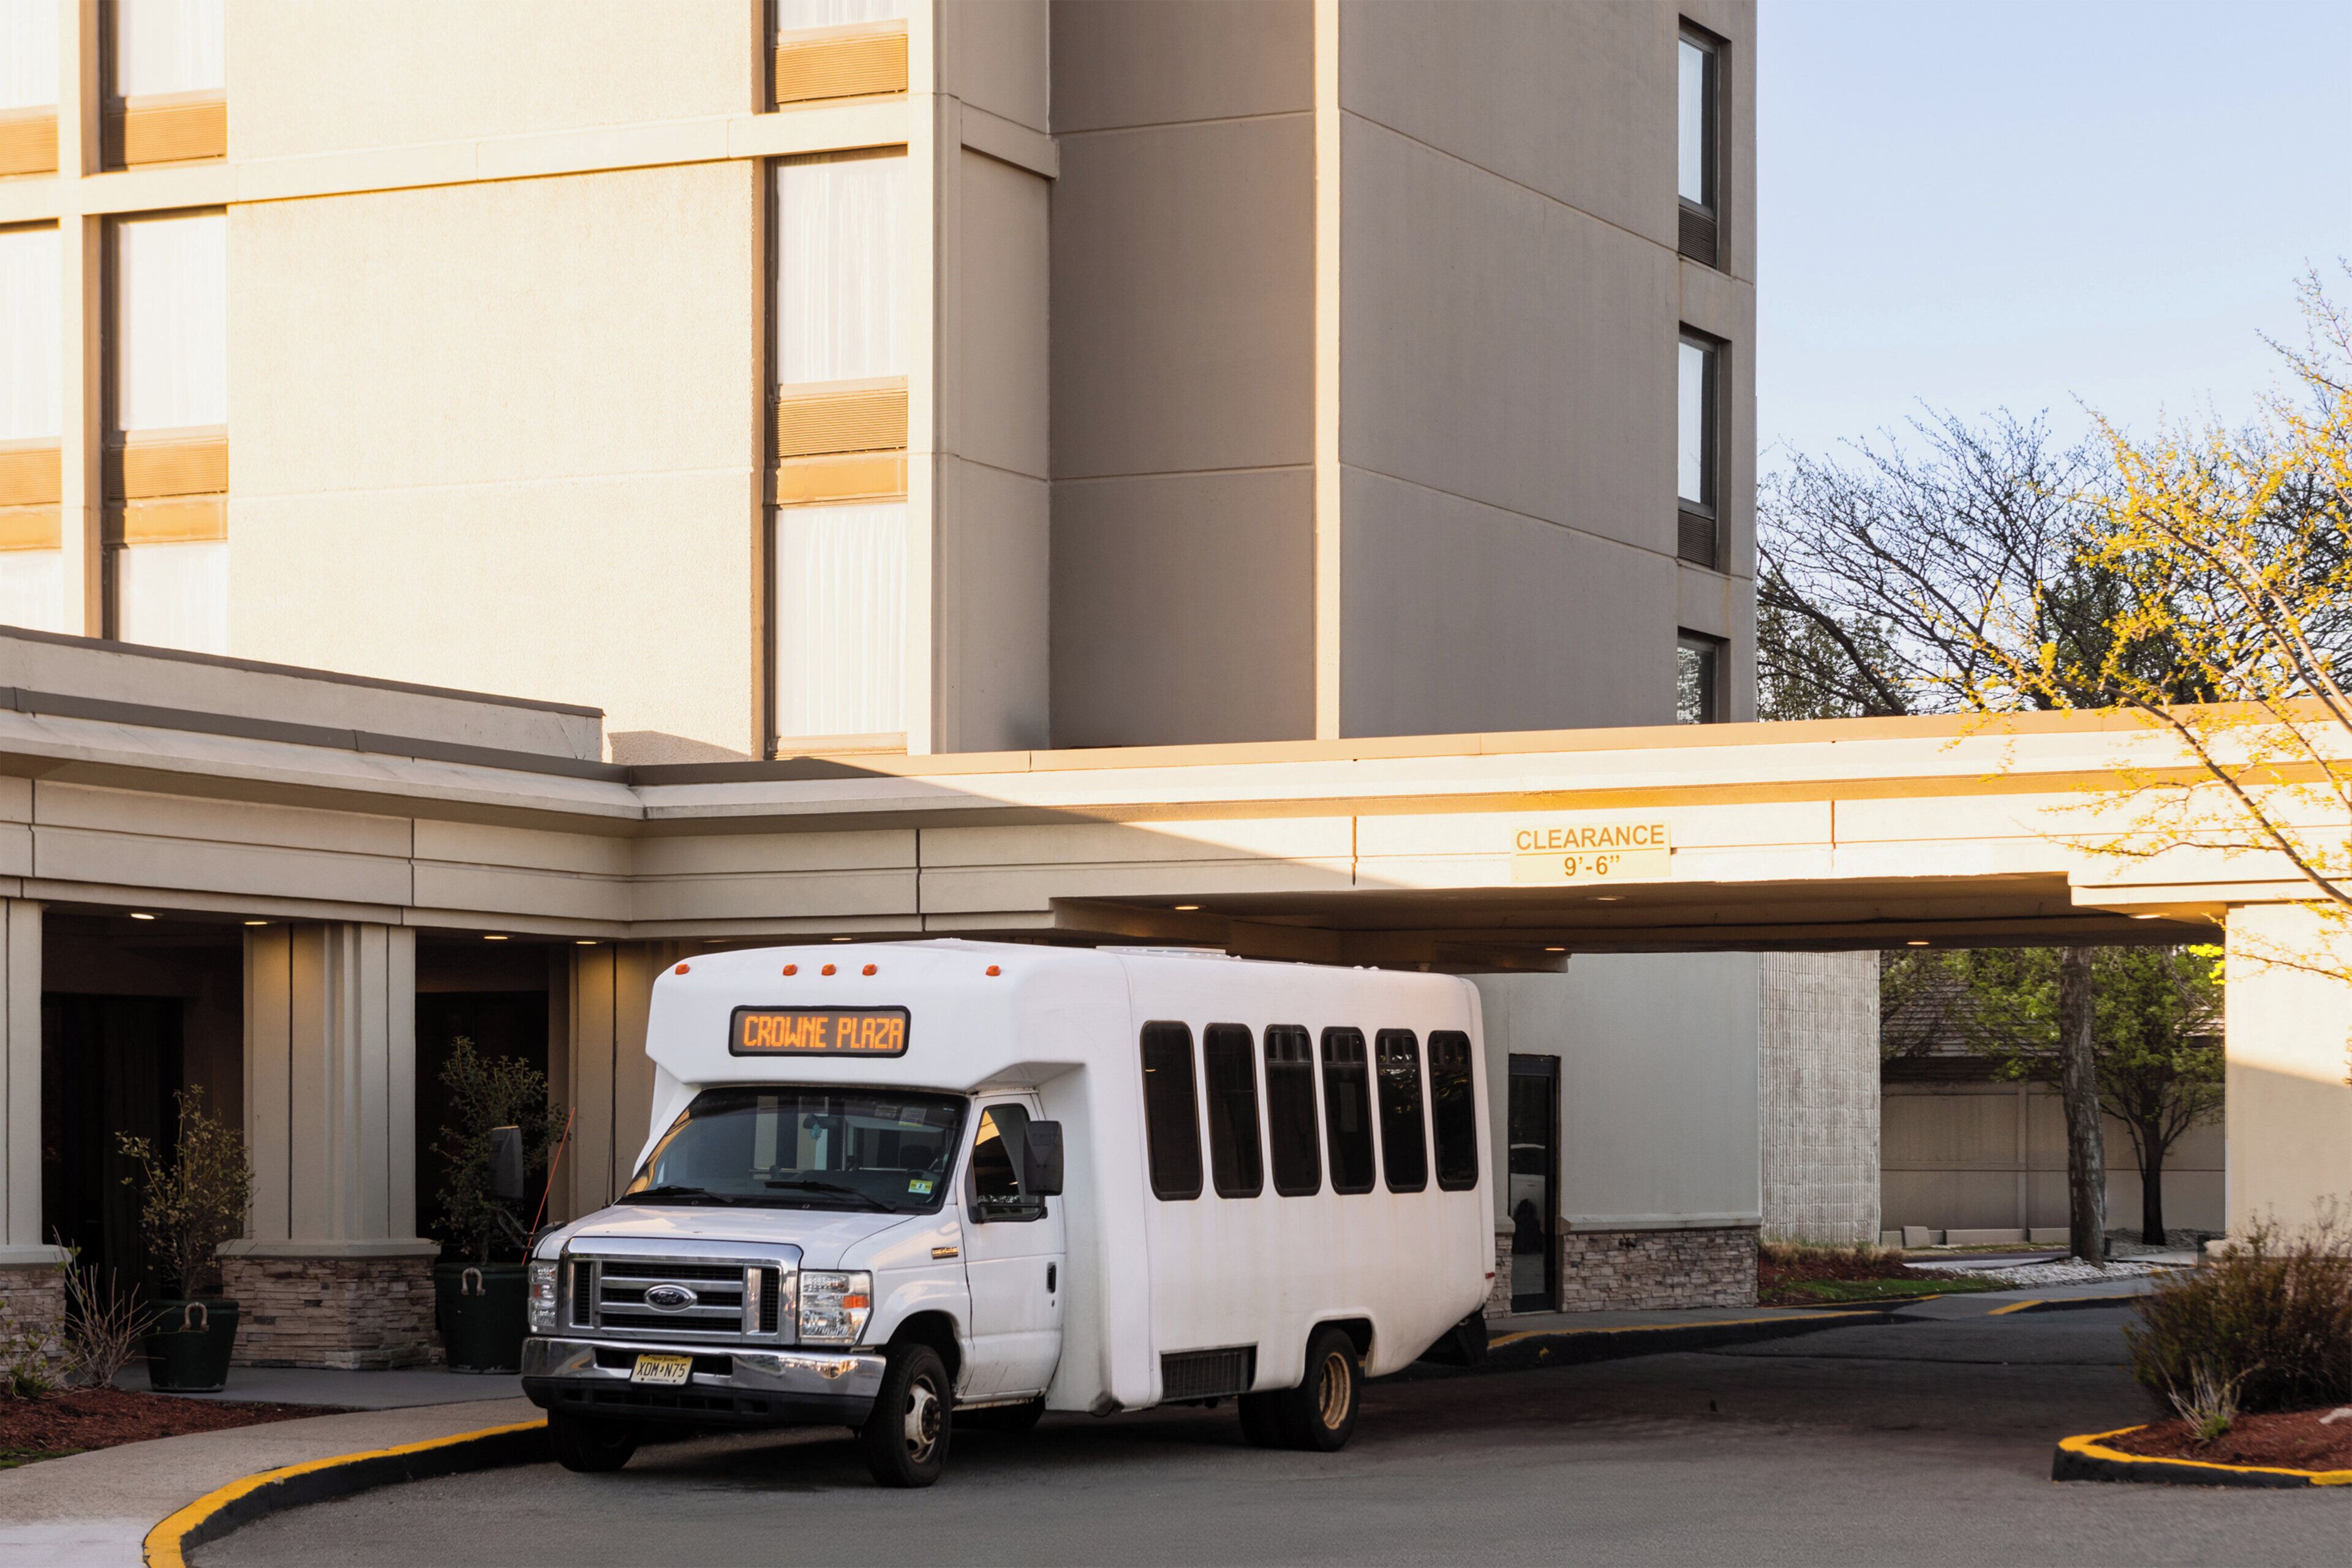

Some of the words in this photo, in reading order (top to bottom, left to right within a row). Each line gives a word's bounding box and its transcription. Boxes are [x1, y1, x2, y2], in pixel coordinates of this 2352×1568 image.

[1516, 824, 1665, 851] CLEARANCE
[743, 1016, 828, 1048] CROWNE
[836, 1017, 903, 1049] PLAZA
[657, 1291, 679, 1303] Ford
